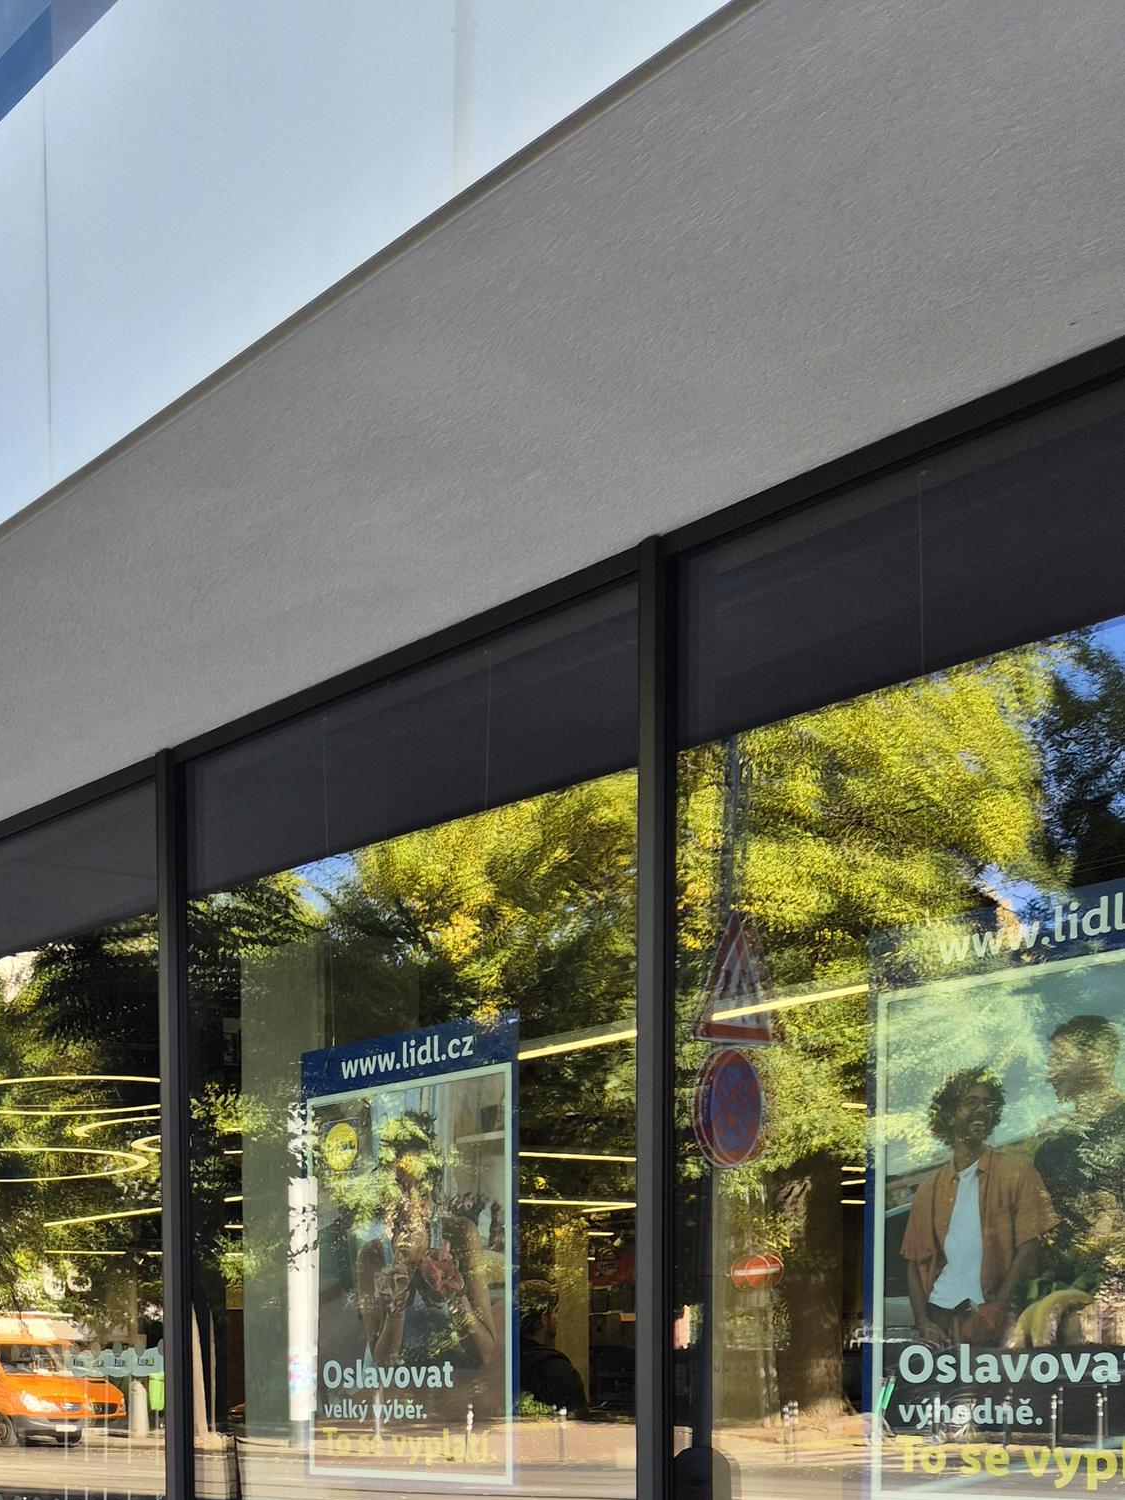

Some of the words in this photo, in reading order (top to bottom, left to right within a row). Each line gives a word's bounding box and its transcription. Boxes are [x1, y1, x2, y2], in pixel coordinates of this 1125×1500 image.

[341, 1034, 474, 1080] www.lidl.cz
[322, 1359, 454, 1389] Oslavovat
[324, 1399, 368, 1423] velký
[373, 1399, 428, 1424] výběr.
[898, 1397, 1043, 1430] výhodně.
[896, 1435, 947, 1474] To
[960, 1447, 1011, 1477] se
[1024, 1440, 1125, 1491] vyp
